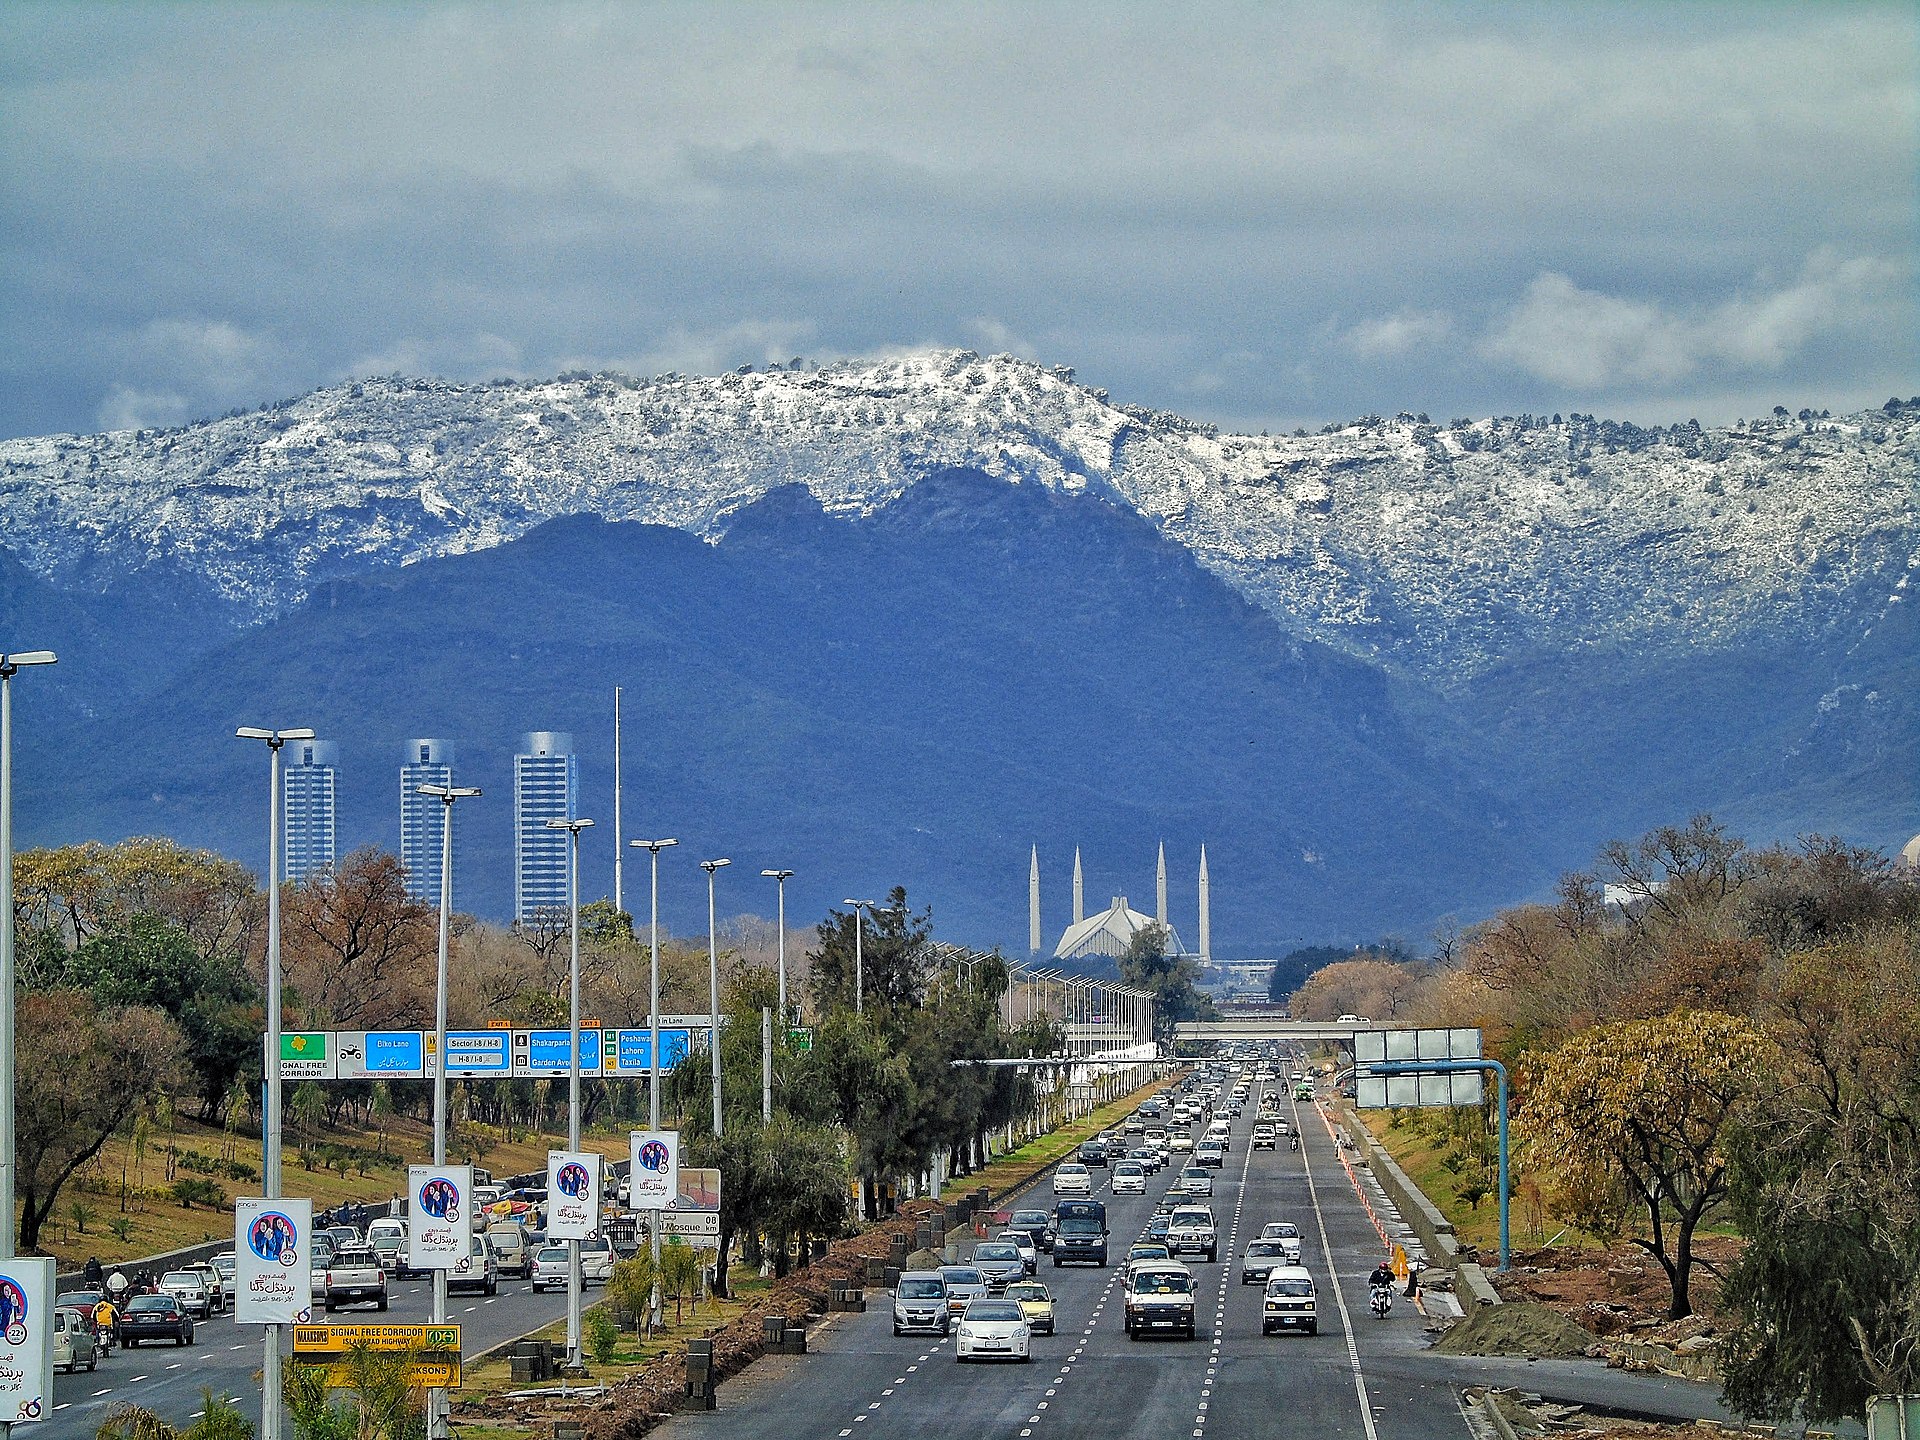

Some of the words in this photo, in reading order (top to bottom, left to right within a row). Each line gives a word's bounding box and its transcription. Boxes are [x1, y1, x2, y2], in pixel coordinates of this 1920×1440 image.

[531, 1039, 571, 1047] Shakarparia
[621, 1058, 641, 1066] Taxila
[11, 1329, 20, 1337] 22
[330, 1328, 360, 1337] SIGNAL
[361, 1328, 380, 1337] FREE
[382, 1327, 423, 1337] CORRIDOR
[382, 1337, 411, 1345] HIGHWAY
